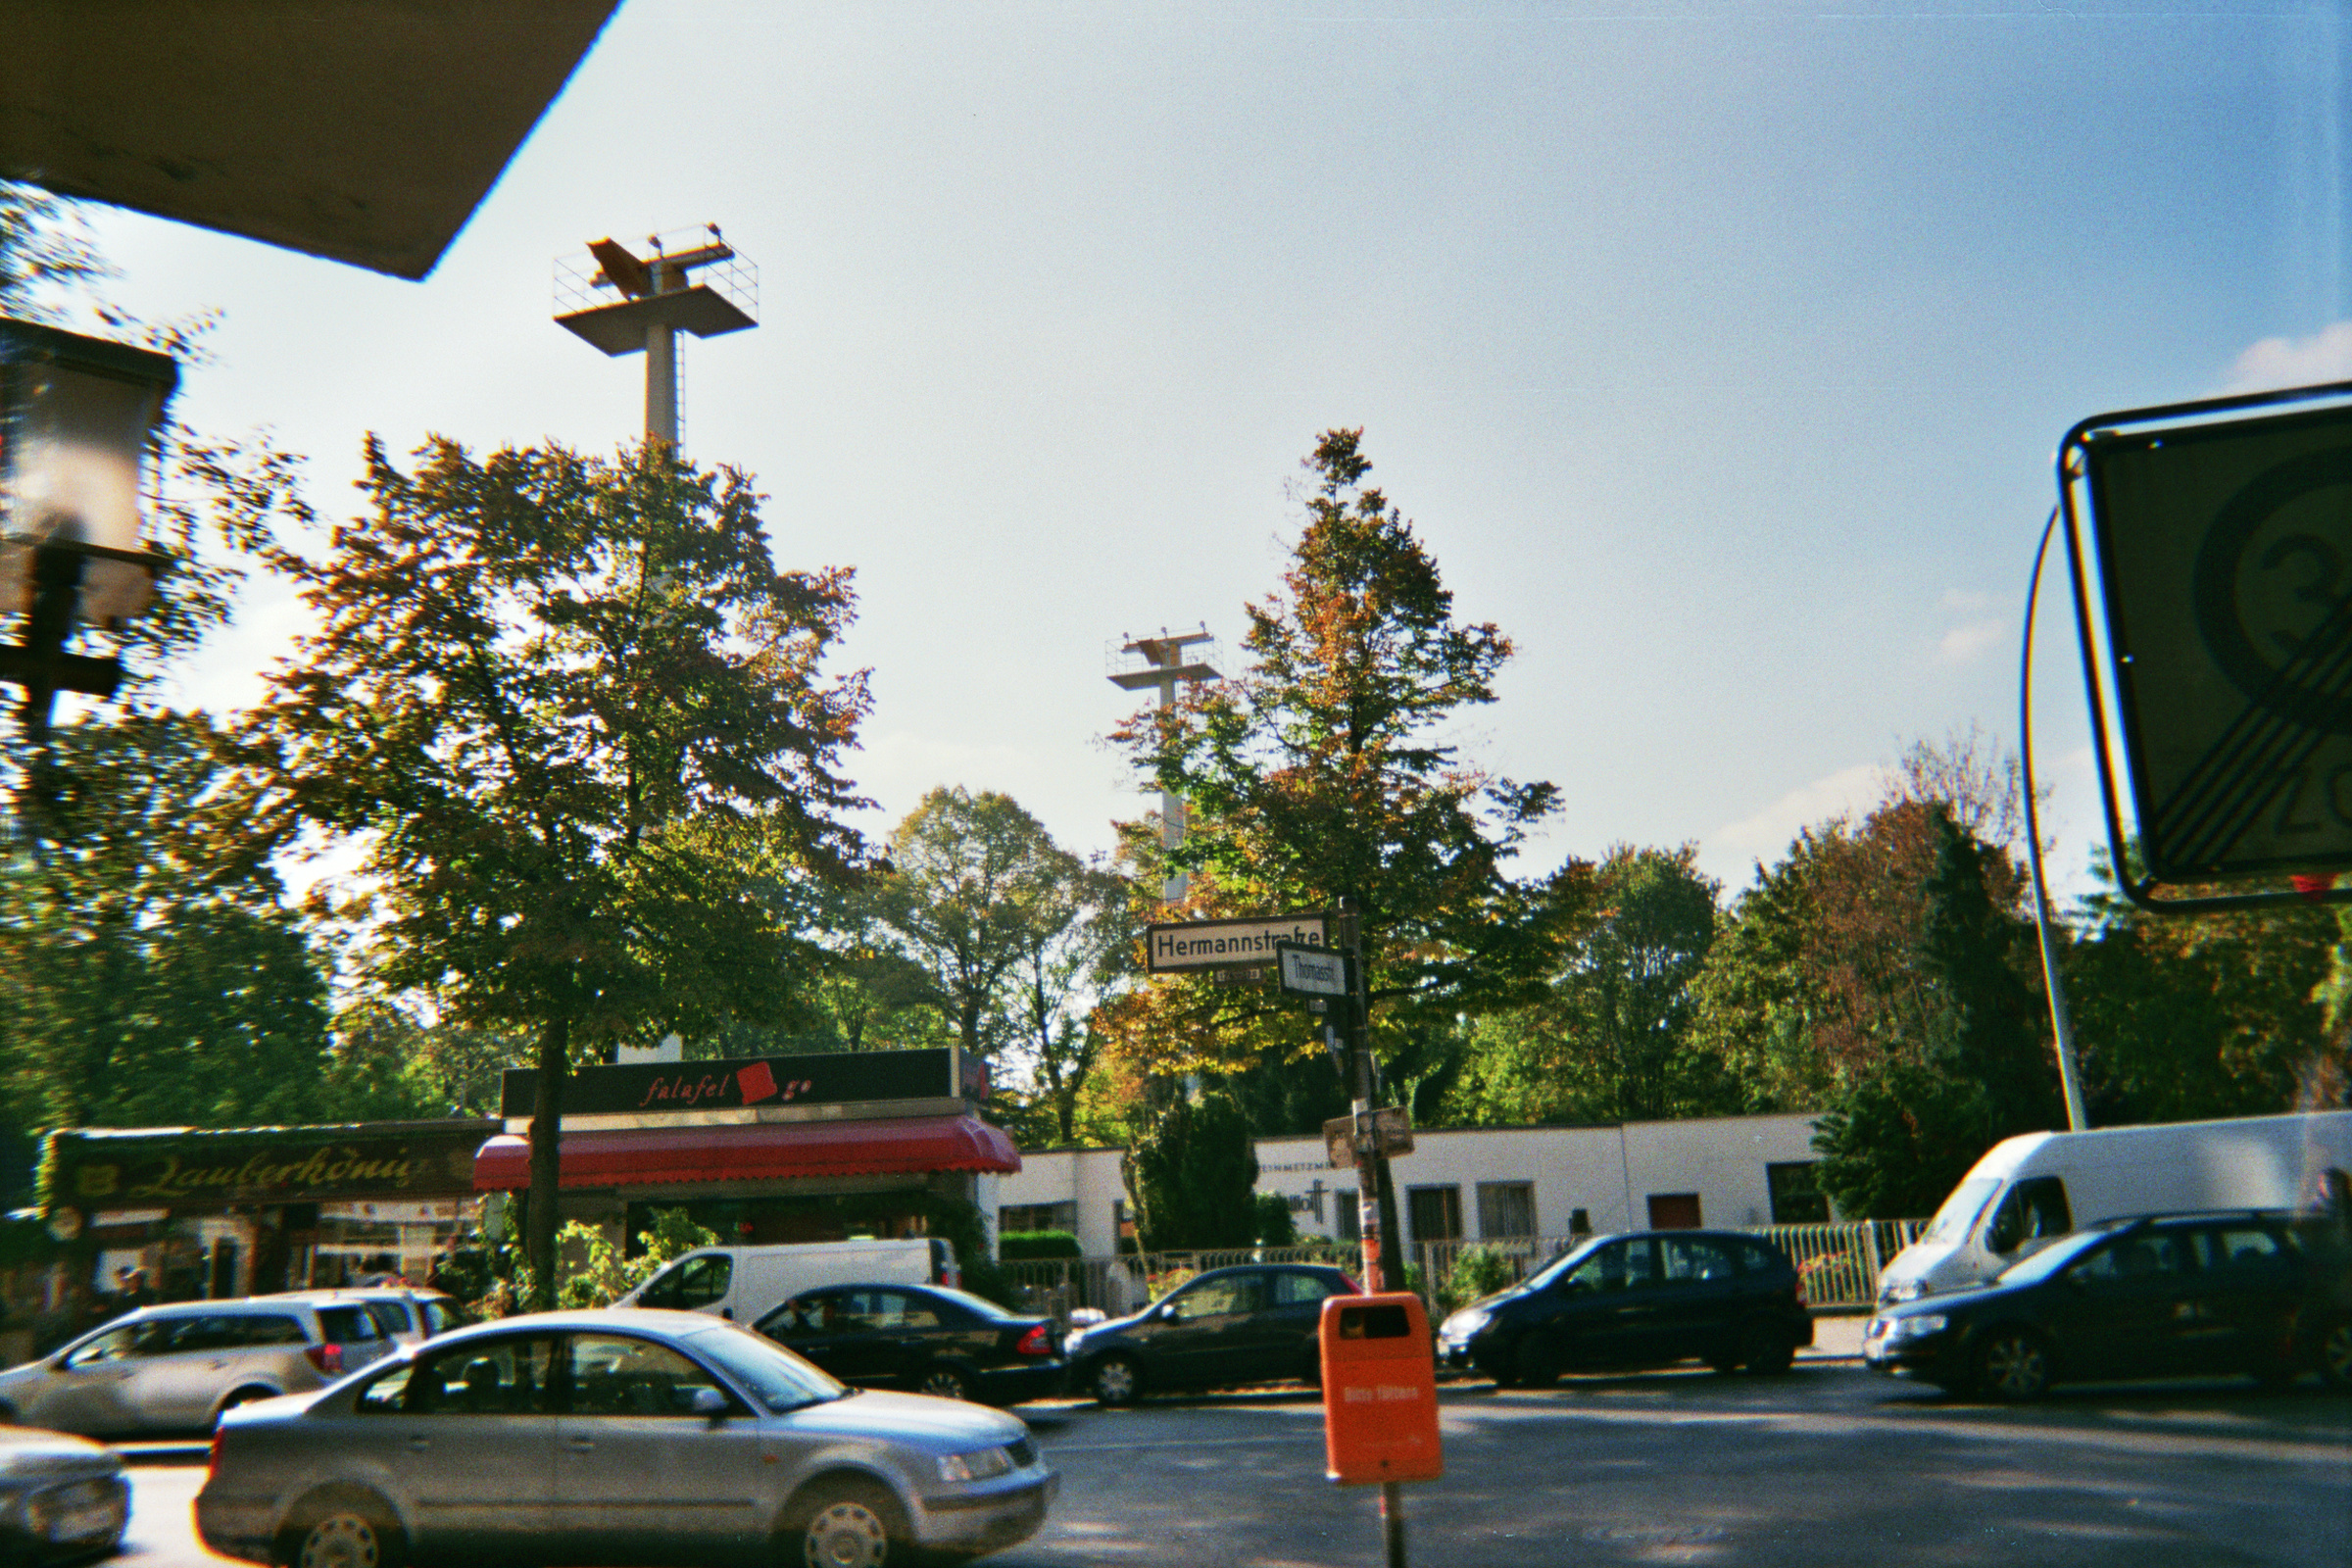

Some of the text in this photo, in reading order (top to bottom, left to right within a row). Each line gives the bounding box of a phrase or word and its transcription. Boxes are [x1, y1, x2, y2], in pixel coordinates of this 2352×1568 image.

[1157, 926, 1320, 956] Hermannstraße
[639, 1074, 812, 1106] falafel go
